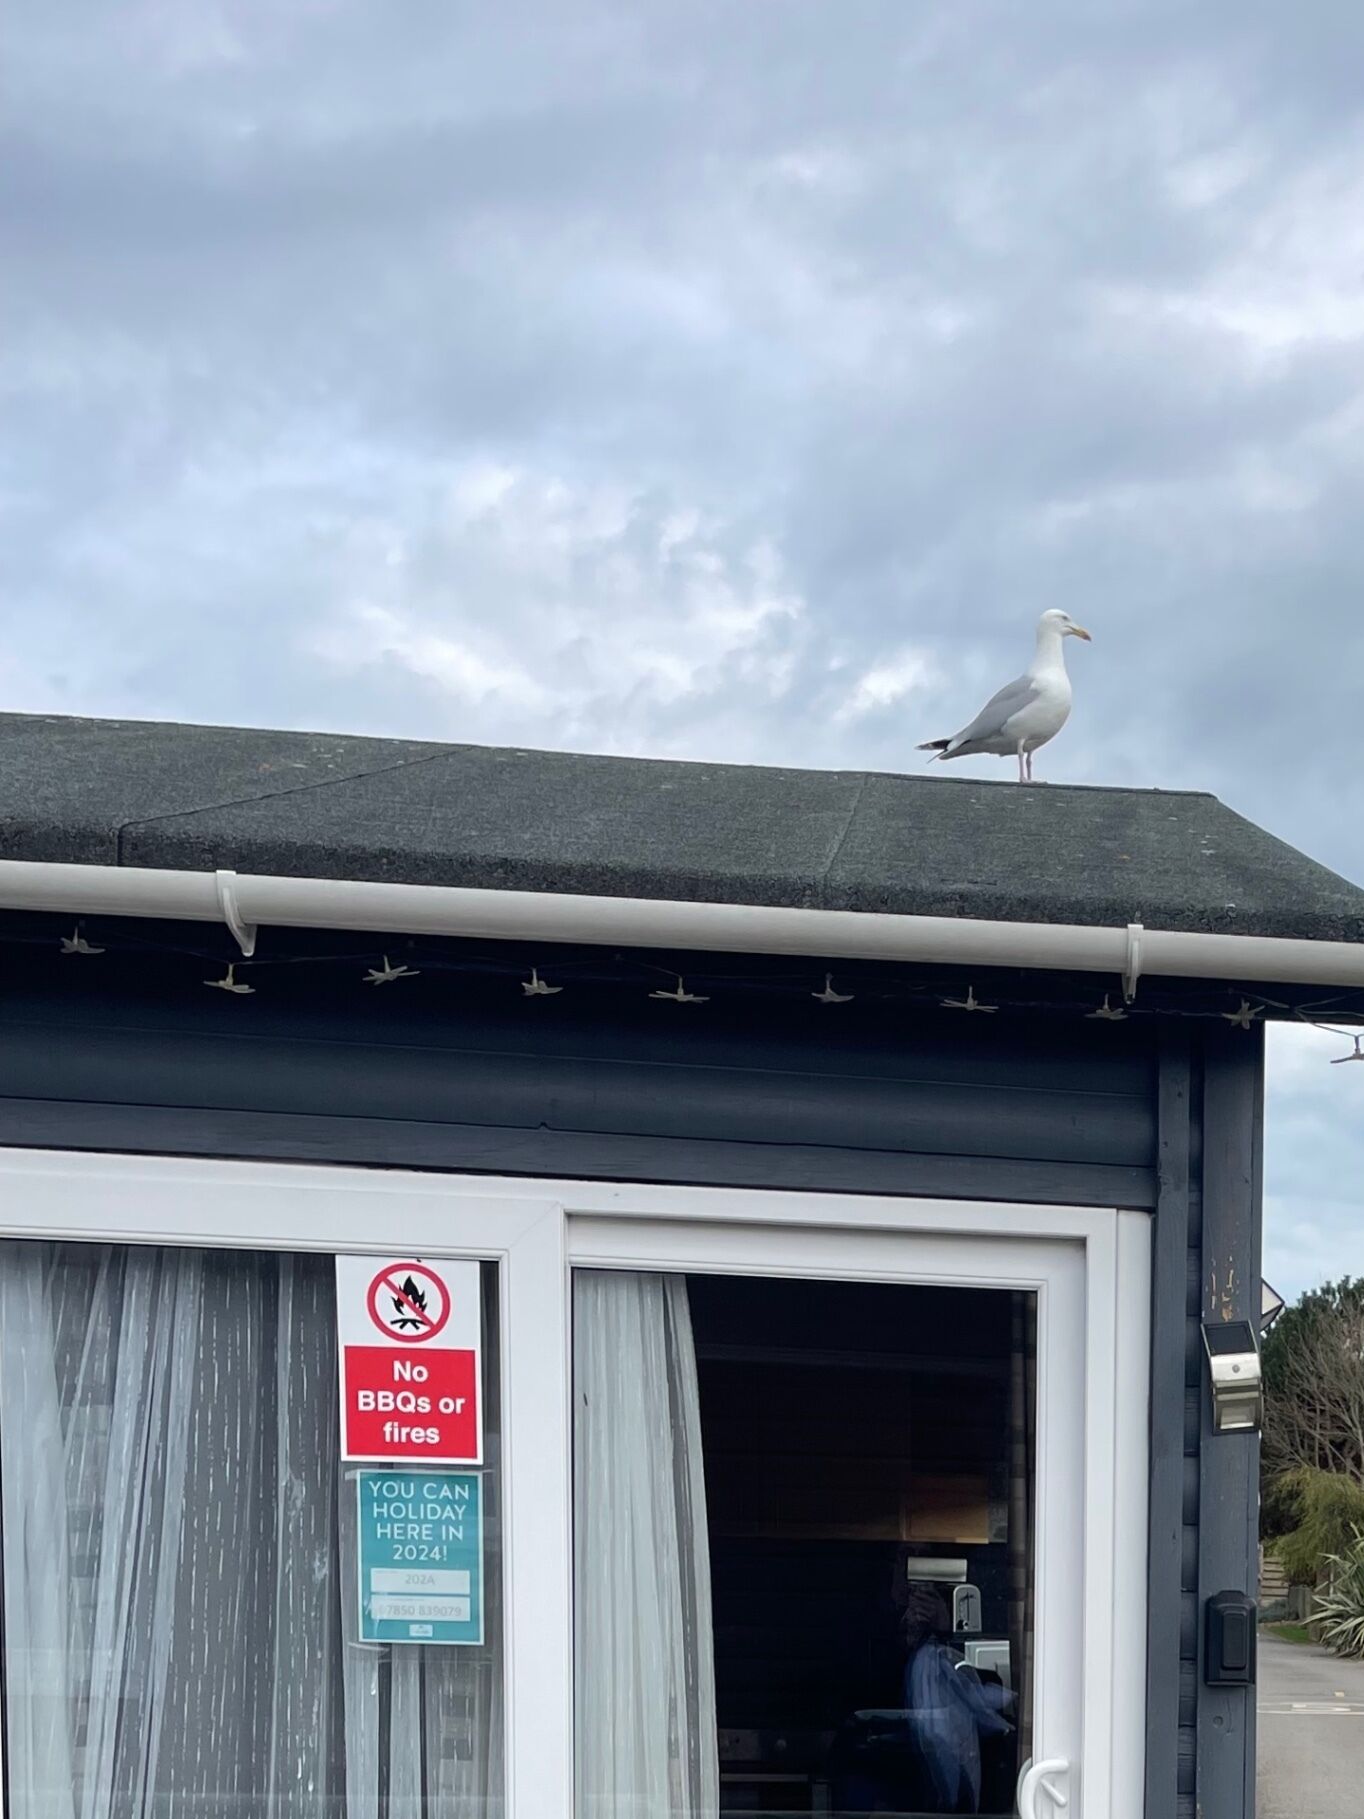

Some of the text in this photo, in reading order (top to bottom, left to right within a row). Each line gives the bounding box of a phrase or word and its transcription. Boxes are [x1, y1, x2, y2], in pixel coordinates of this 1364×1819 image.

[393, 1360, 429, 1382] No
[357, 1390, 466, 1414] BBQs or
[383, 1421, 440, 1444] fires
[368, 1481, 469, 1500] YOU CAN
[373, 1502, 466, 1520] HOLIDAY
[377, 1523, 464, 1541] HERE IN
[393, 1544, 447, 1561] 2024!
[405, 1574, 435, 1585] 202A
